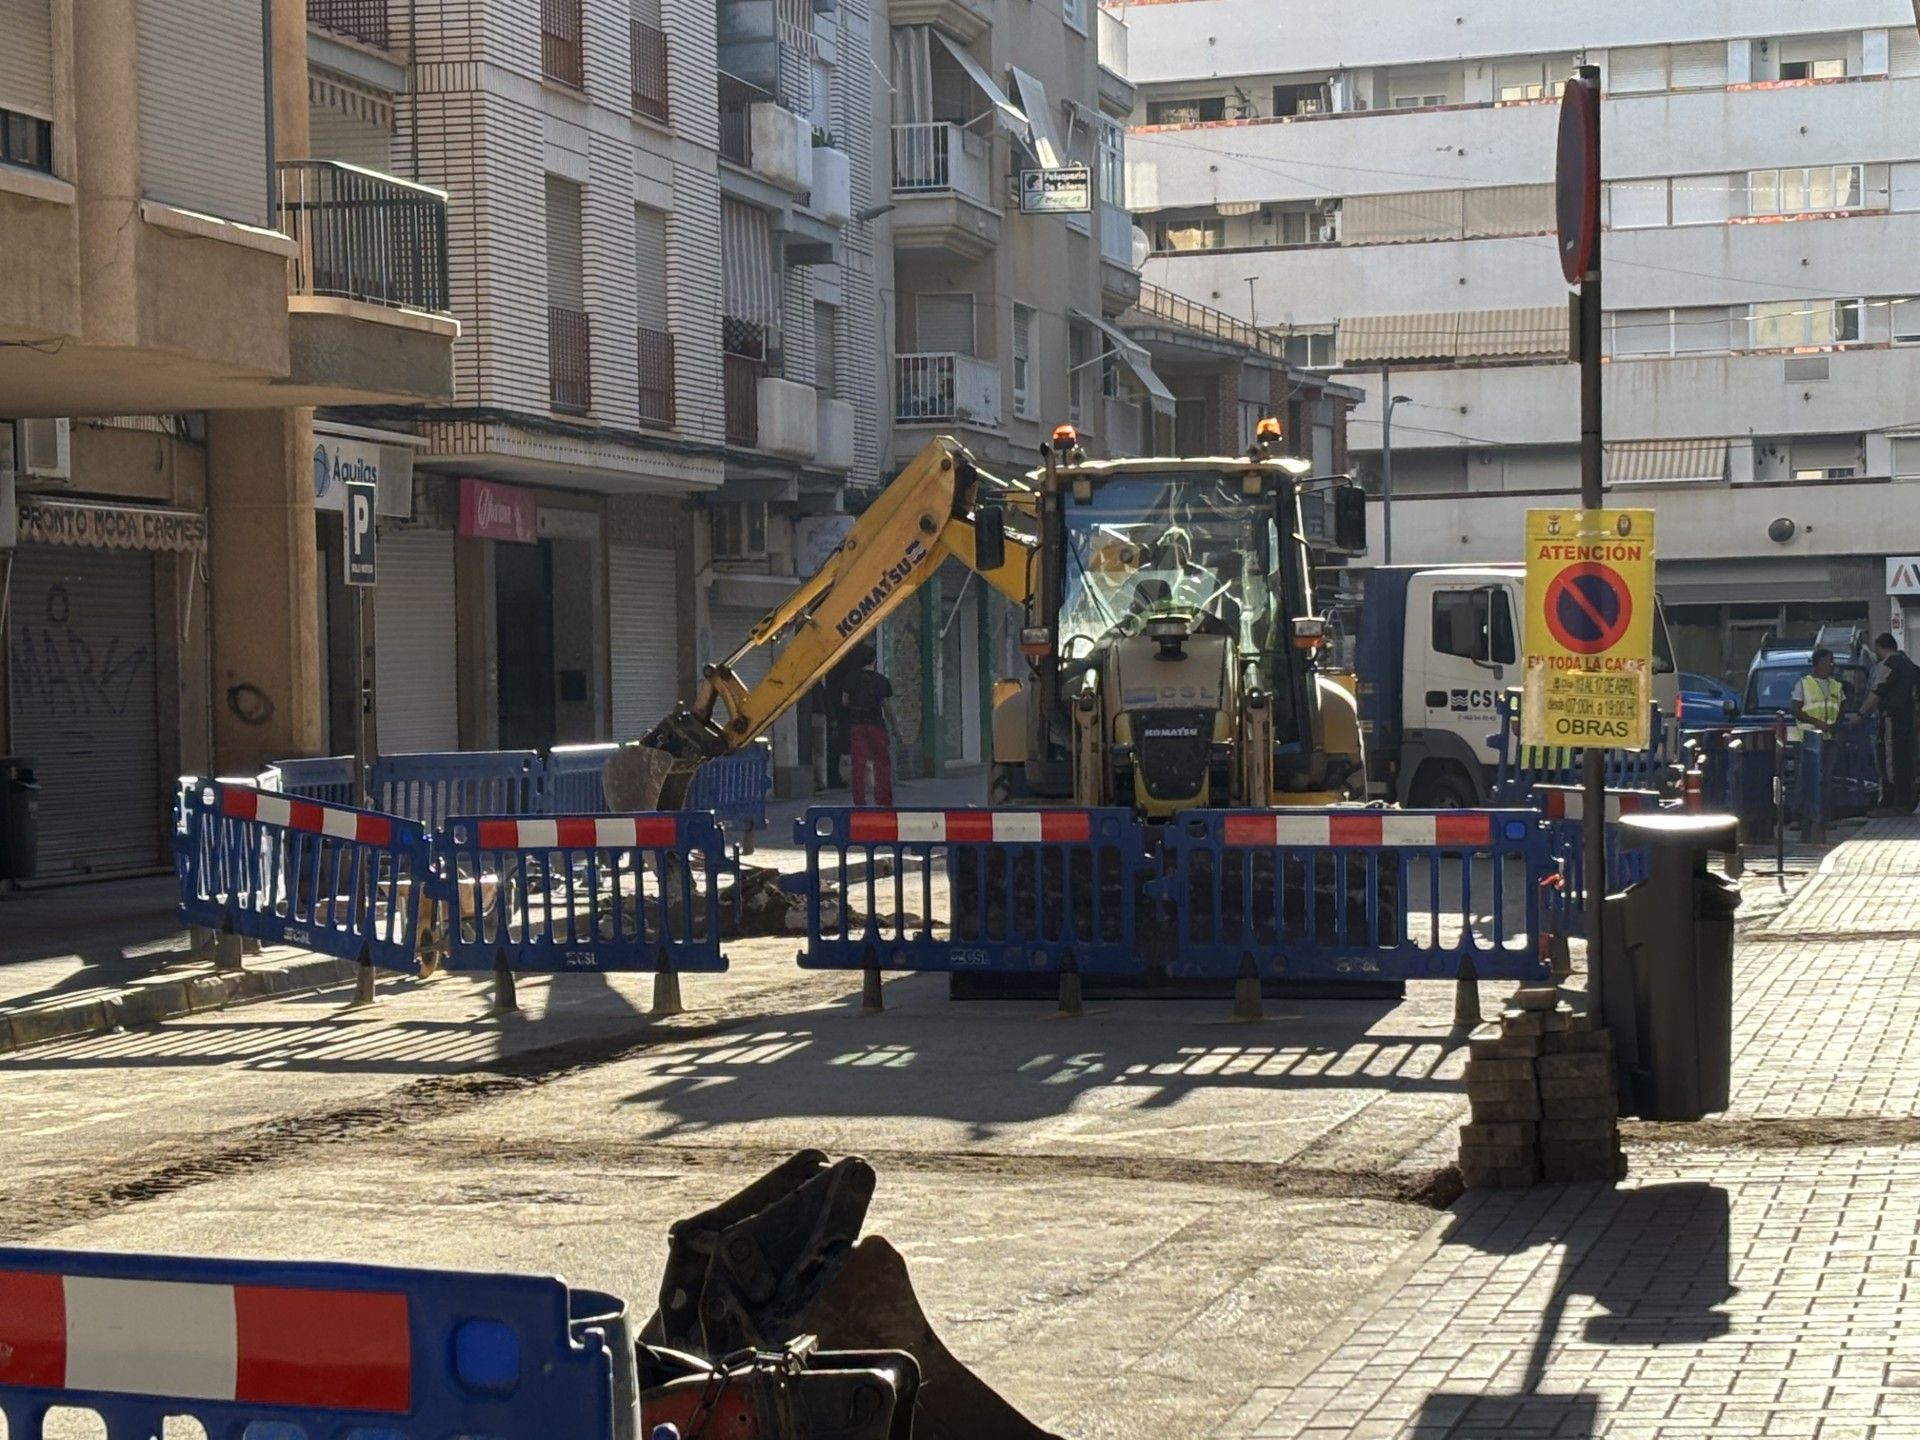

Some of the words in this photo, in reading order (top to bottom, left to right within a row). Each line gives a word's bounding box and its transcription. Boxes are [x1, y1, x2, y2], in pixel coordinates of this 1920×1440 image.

[18, 505, 88, 535] PRONTO
[94, 511, 138, 538] MODA
[354, 495, 369, 555] P
[1537, 543, 1642, 561] ATENCIÓN
[835, 557, 912, 638] KOMATSU
[1548, 656, 1581, 670] TODA
[1585, 658, 1600, 670] LA
[1144, 727, 1198, 737] KOMATSU
[1556, 718, 1629, 737] OBRAS
